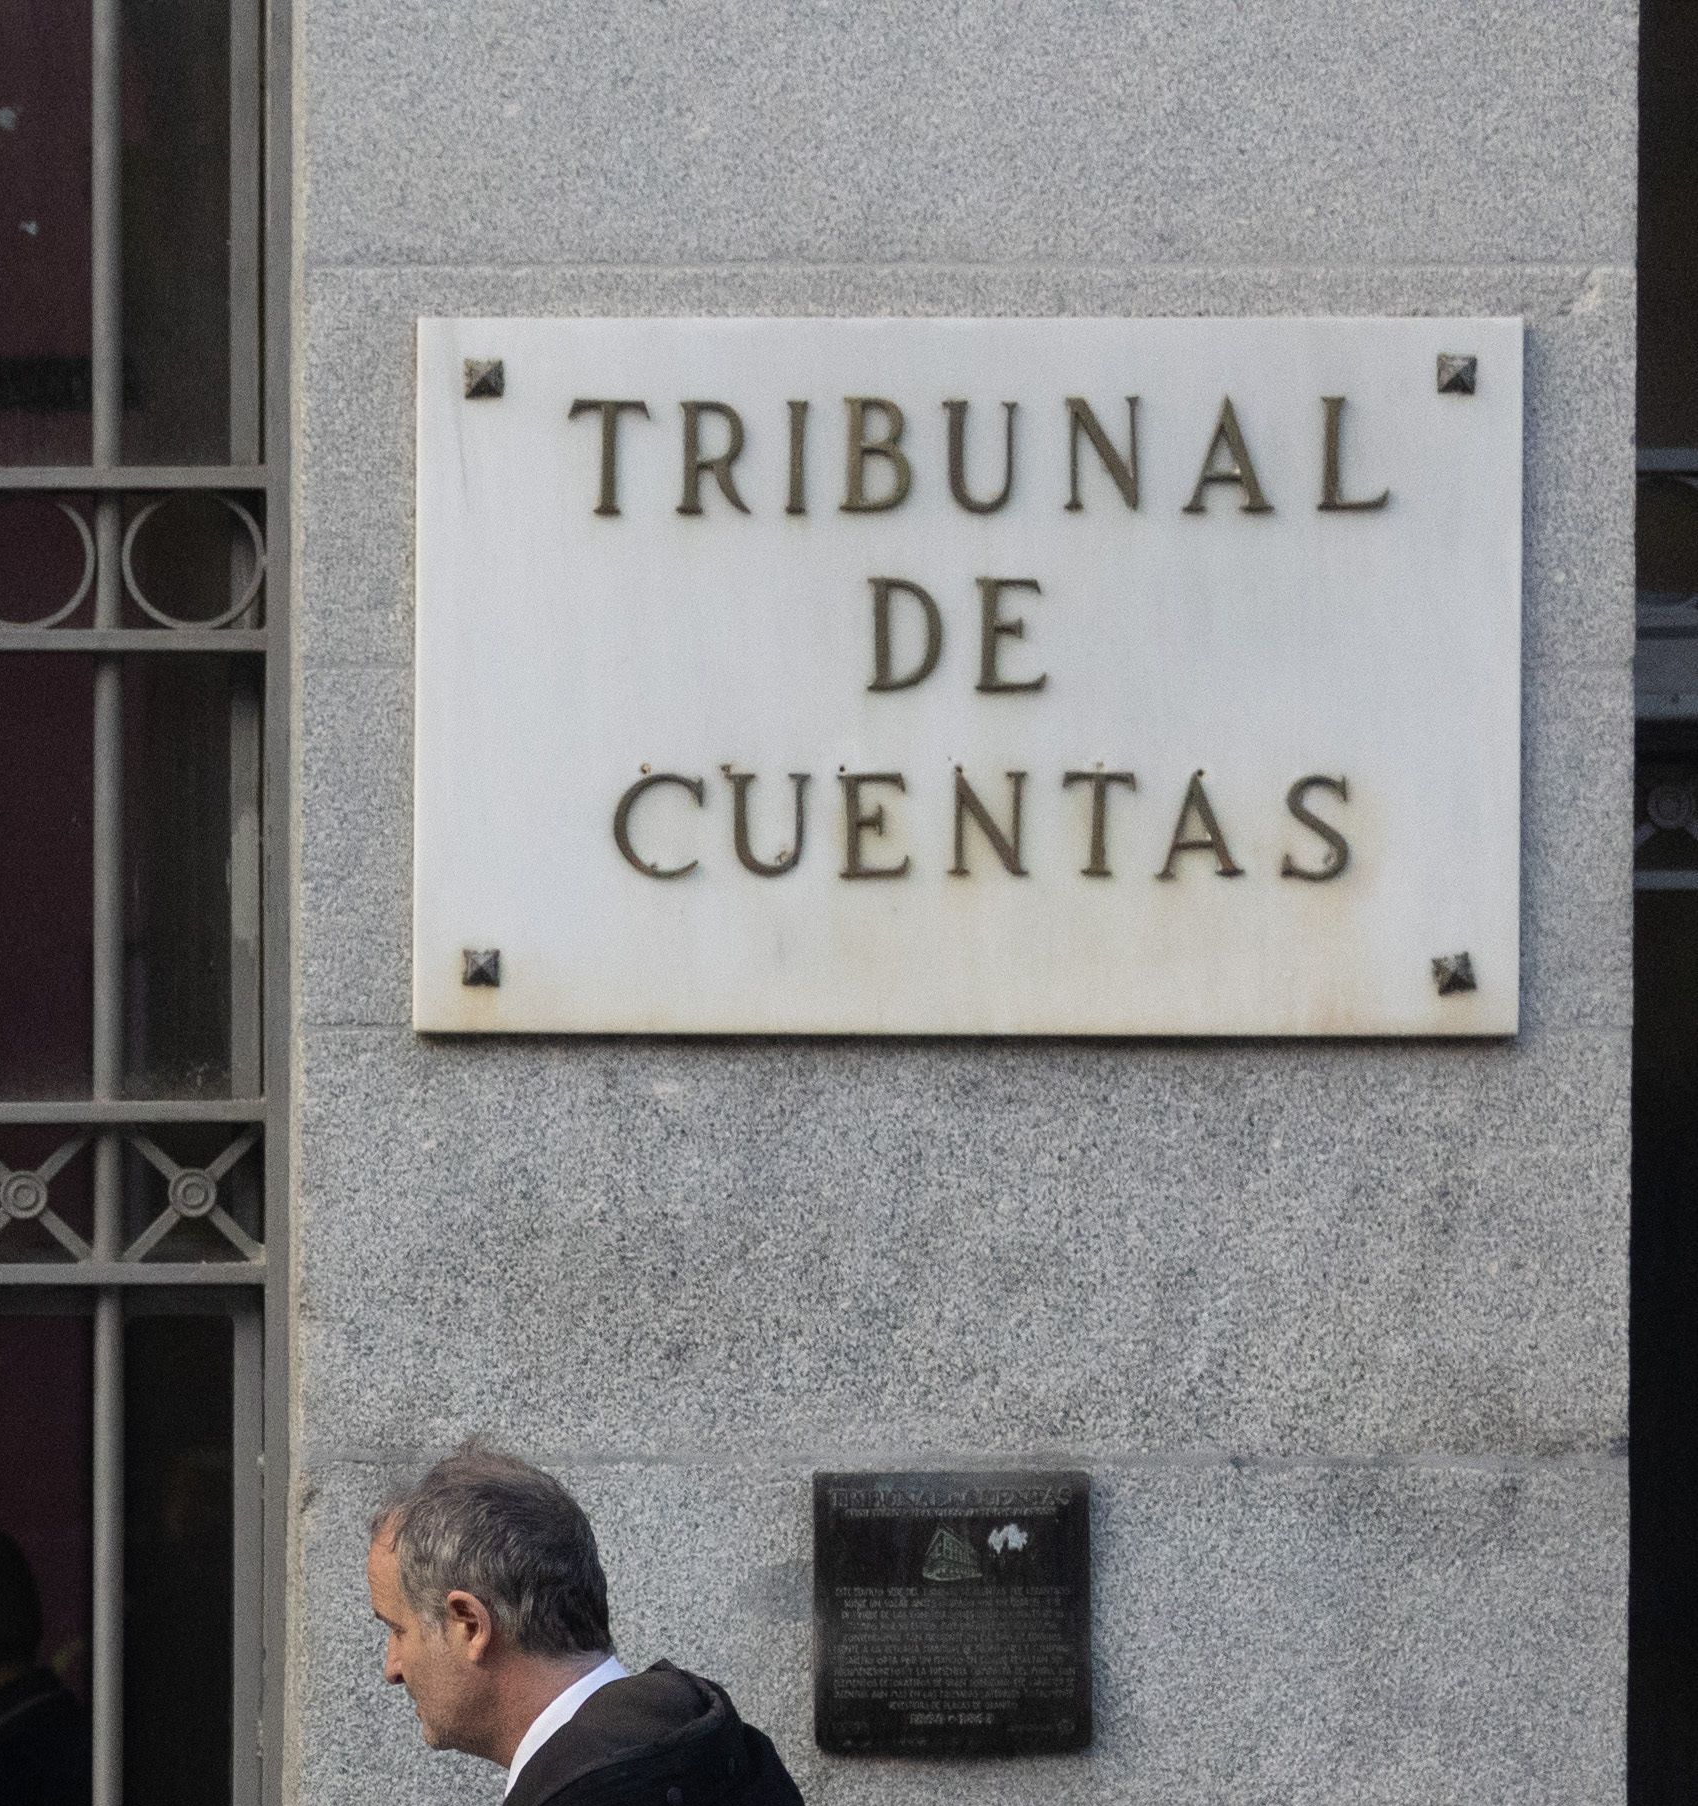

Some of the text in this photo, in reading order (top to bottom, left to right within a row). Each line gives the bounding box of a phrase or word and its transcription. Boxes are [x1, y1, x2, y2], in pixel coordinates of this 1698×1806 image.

[567, 394, 1392, 518] TRIBUNAL
[866, 577, 1050, 695] DE
[610, 769, 1354, 881] CUENTAS
